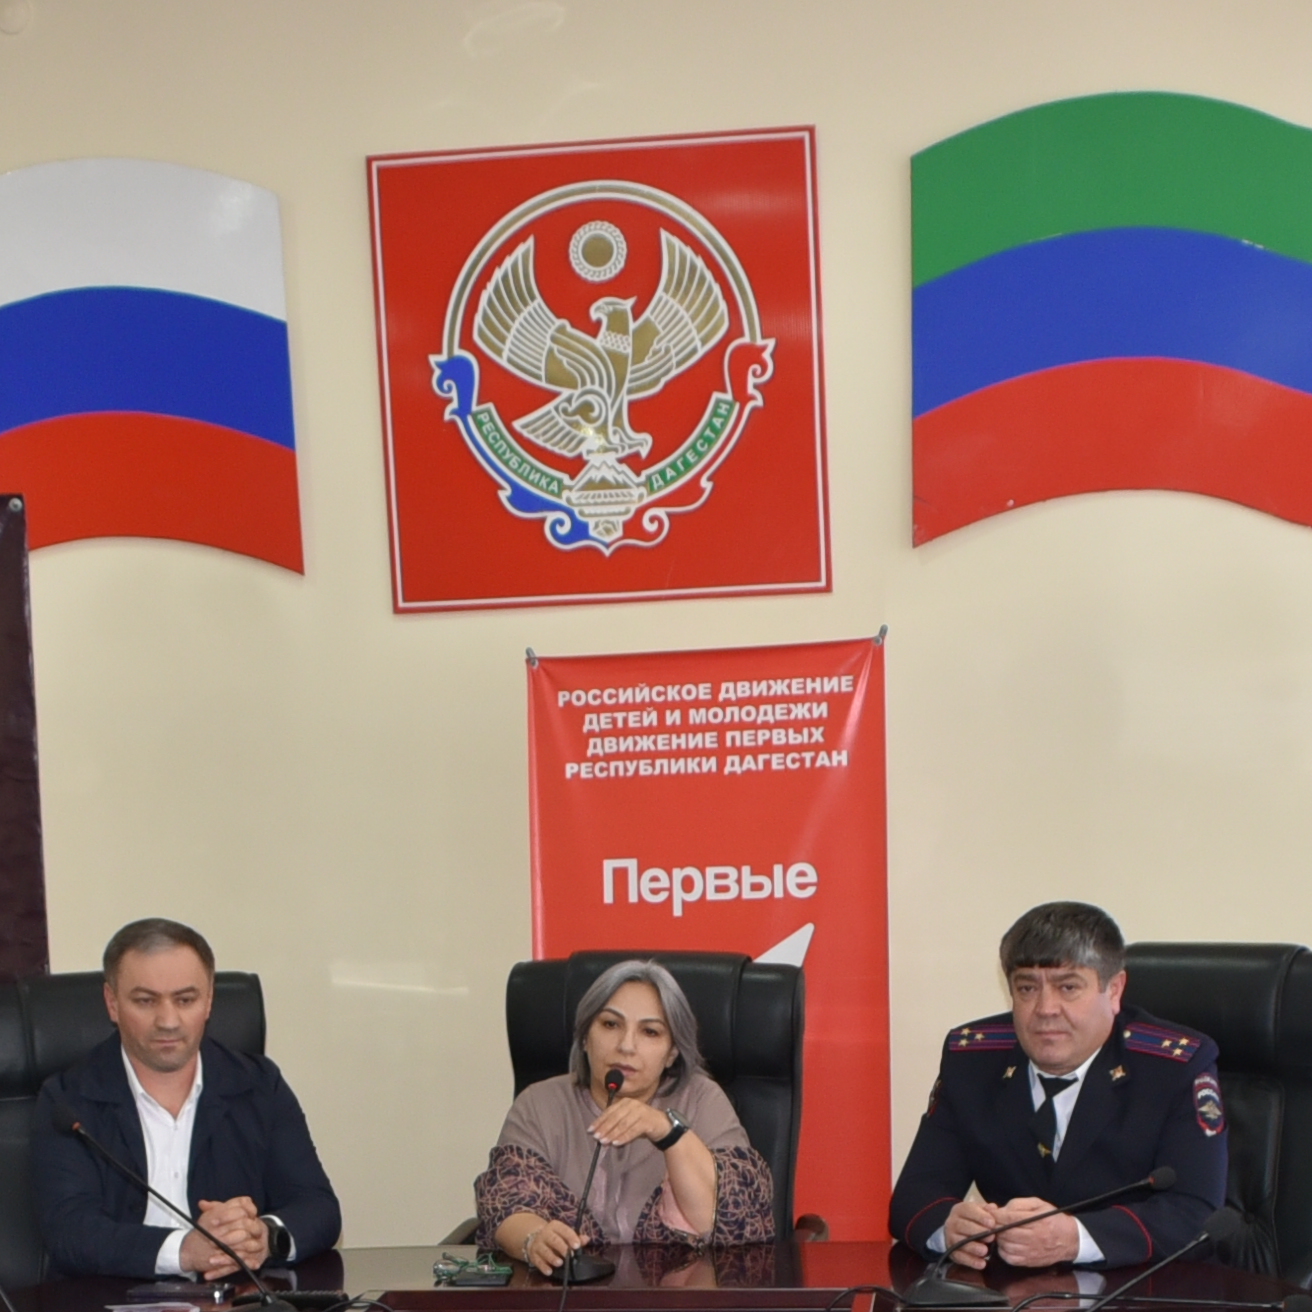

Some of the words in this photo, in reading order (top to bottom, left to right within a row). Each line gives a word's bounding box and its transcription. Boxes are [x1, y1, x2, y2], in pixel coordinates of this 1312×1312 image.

[477, 412, 560, 494] РЕСПУБЛИКА
[651, 402, 730, 489] ДАГЕСТАН
[558, 683, 712, 707] РОССИЙСКОЕ
[719, 676, 853, 701] ДВИЖЕНИЕ
[583, 708, 657, 732] ДЕТЕЙ
[665, 709, 680, 725] И
[690, 702, 828, 726] МОЛОДЕЖИ
[587, 732, 718, 756] ДВИЖЕНИЕ
[726, 727, 824, 746] ПЕРВЫХ
[565, 757, 716, 779] РЕСПУБЛИКИ
[724, 750, 848, 775] ДАГЕСТАН
[603, 858, 818, 917] Первые
